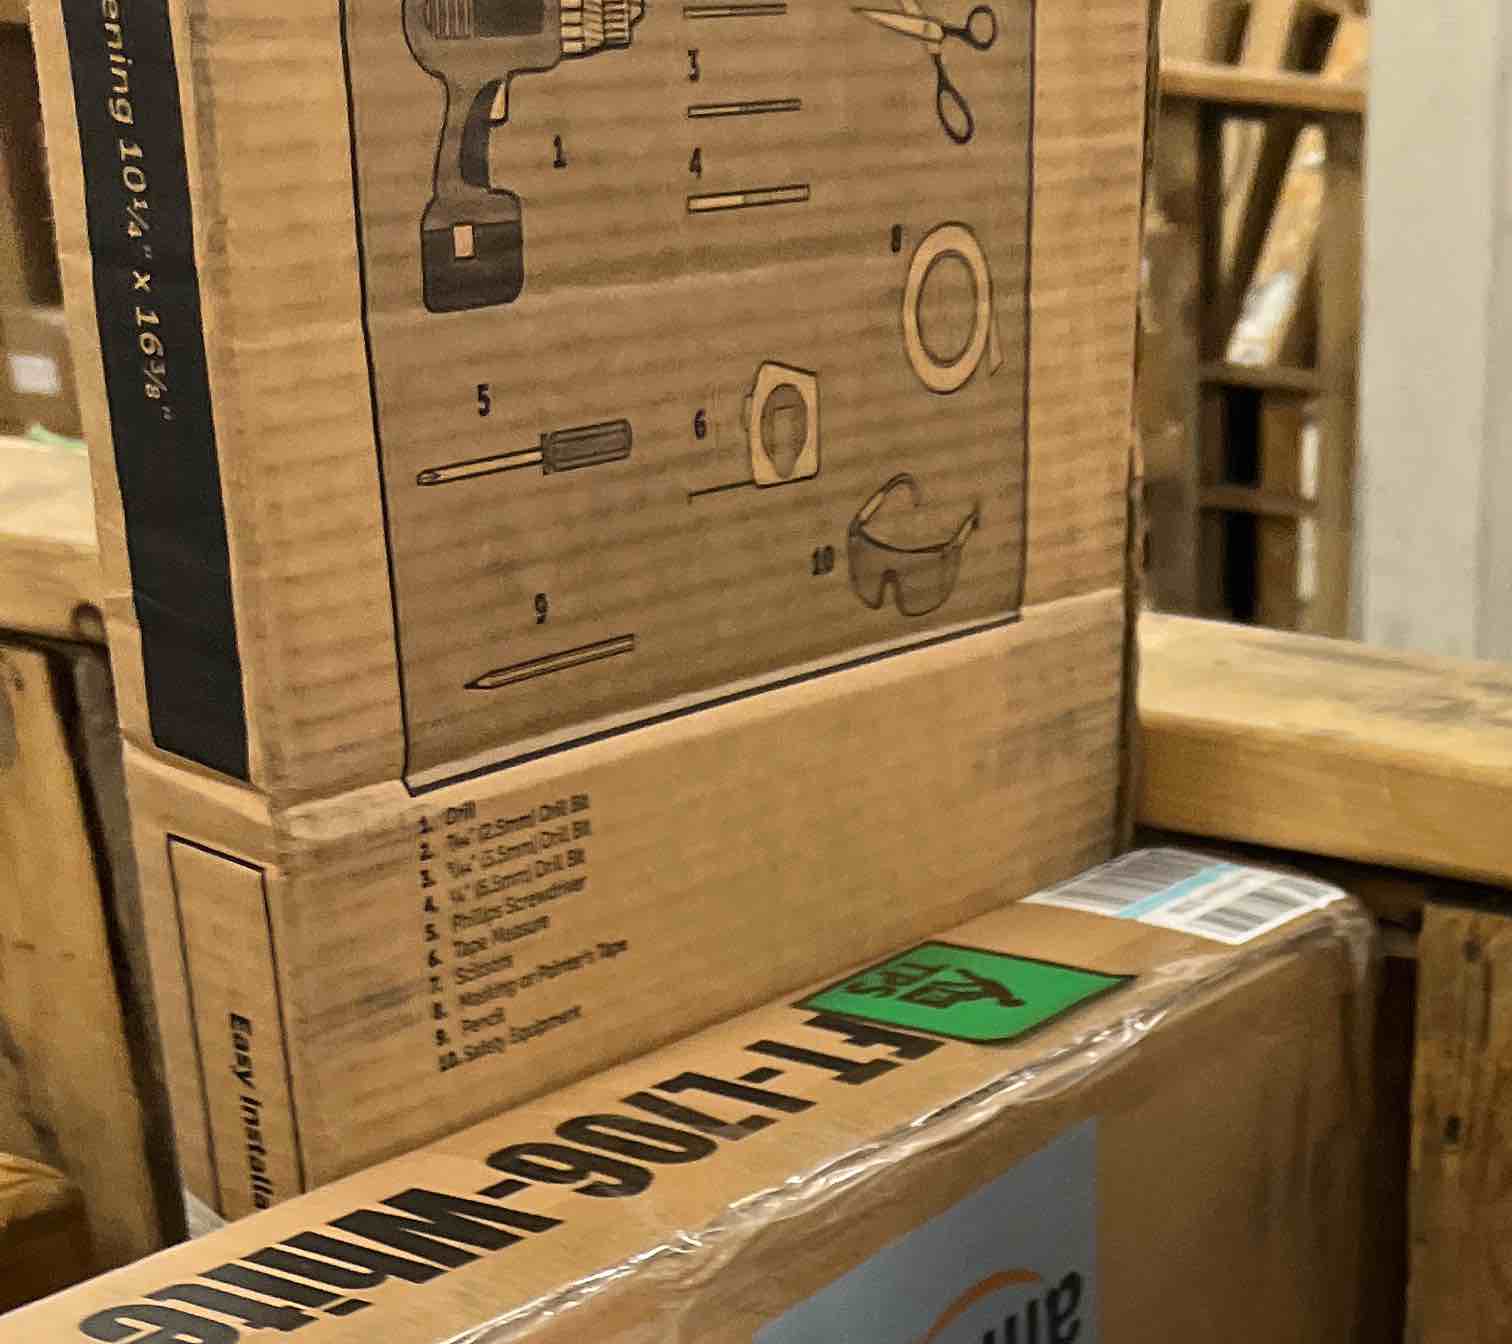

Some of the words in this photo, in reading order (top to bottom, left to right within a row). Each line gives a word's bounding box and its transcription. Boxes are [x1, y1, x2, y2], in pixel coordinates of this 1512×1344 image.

[553, 136, 567, 169] 1
[689, 147, 702, 178] 4
[477, 384, 491, 417] 5
[693, 408, 707, 440] 6
[229, 1012, 257, 1090] Easy
